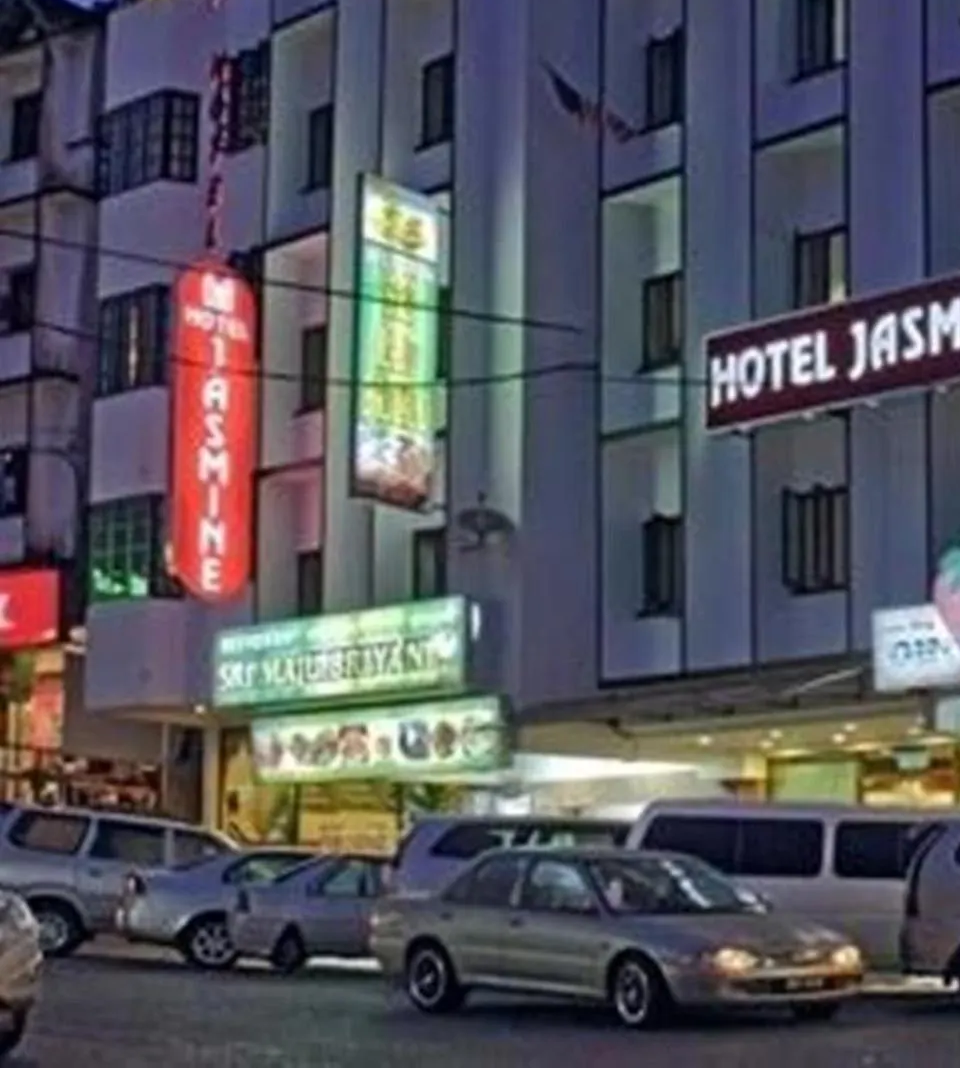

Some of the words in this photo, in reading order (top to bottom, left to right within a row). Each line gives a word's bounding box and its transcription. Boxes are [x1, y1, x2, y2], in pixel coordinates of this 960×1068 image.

[184, 306, 249, 341] HOTEL
[710, 330, 836, 408] HOTEL
[199, 335, 232, 592] JASMINE
